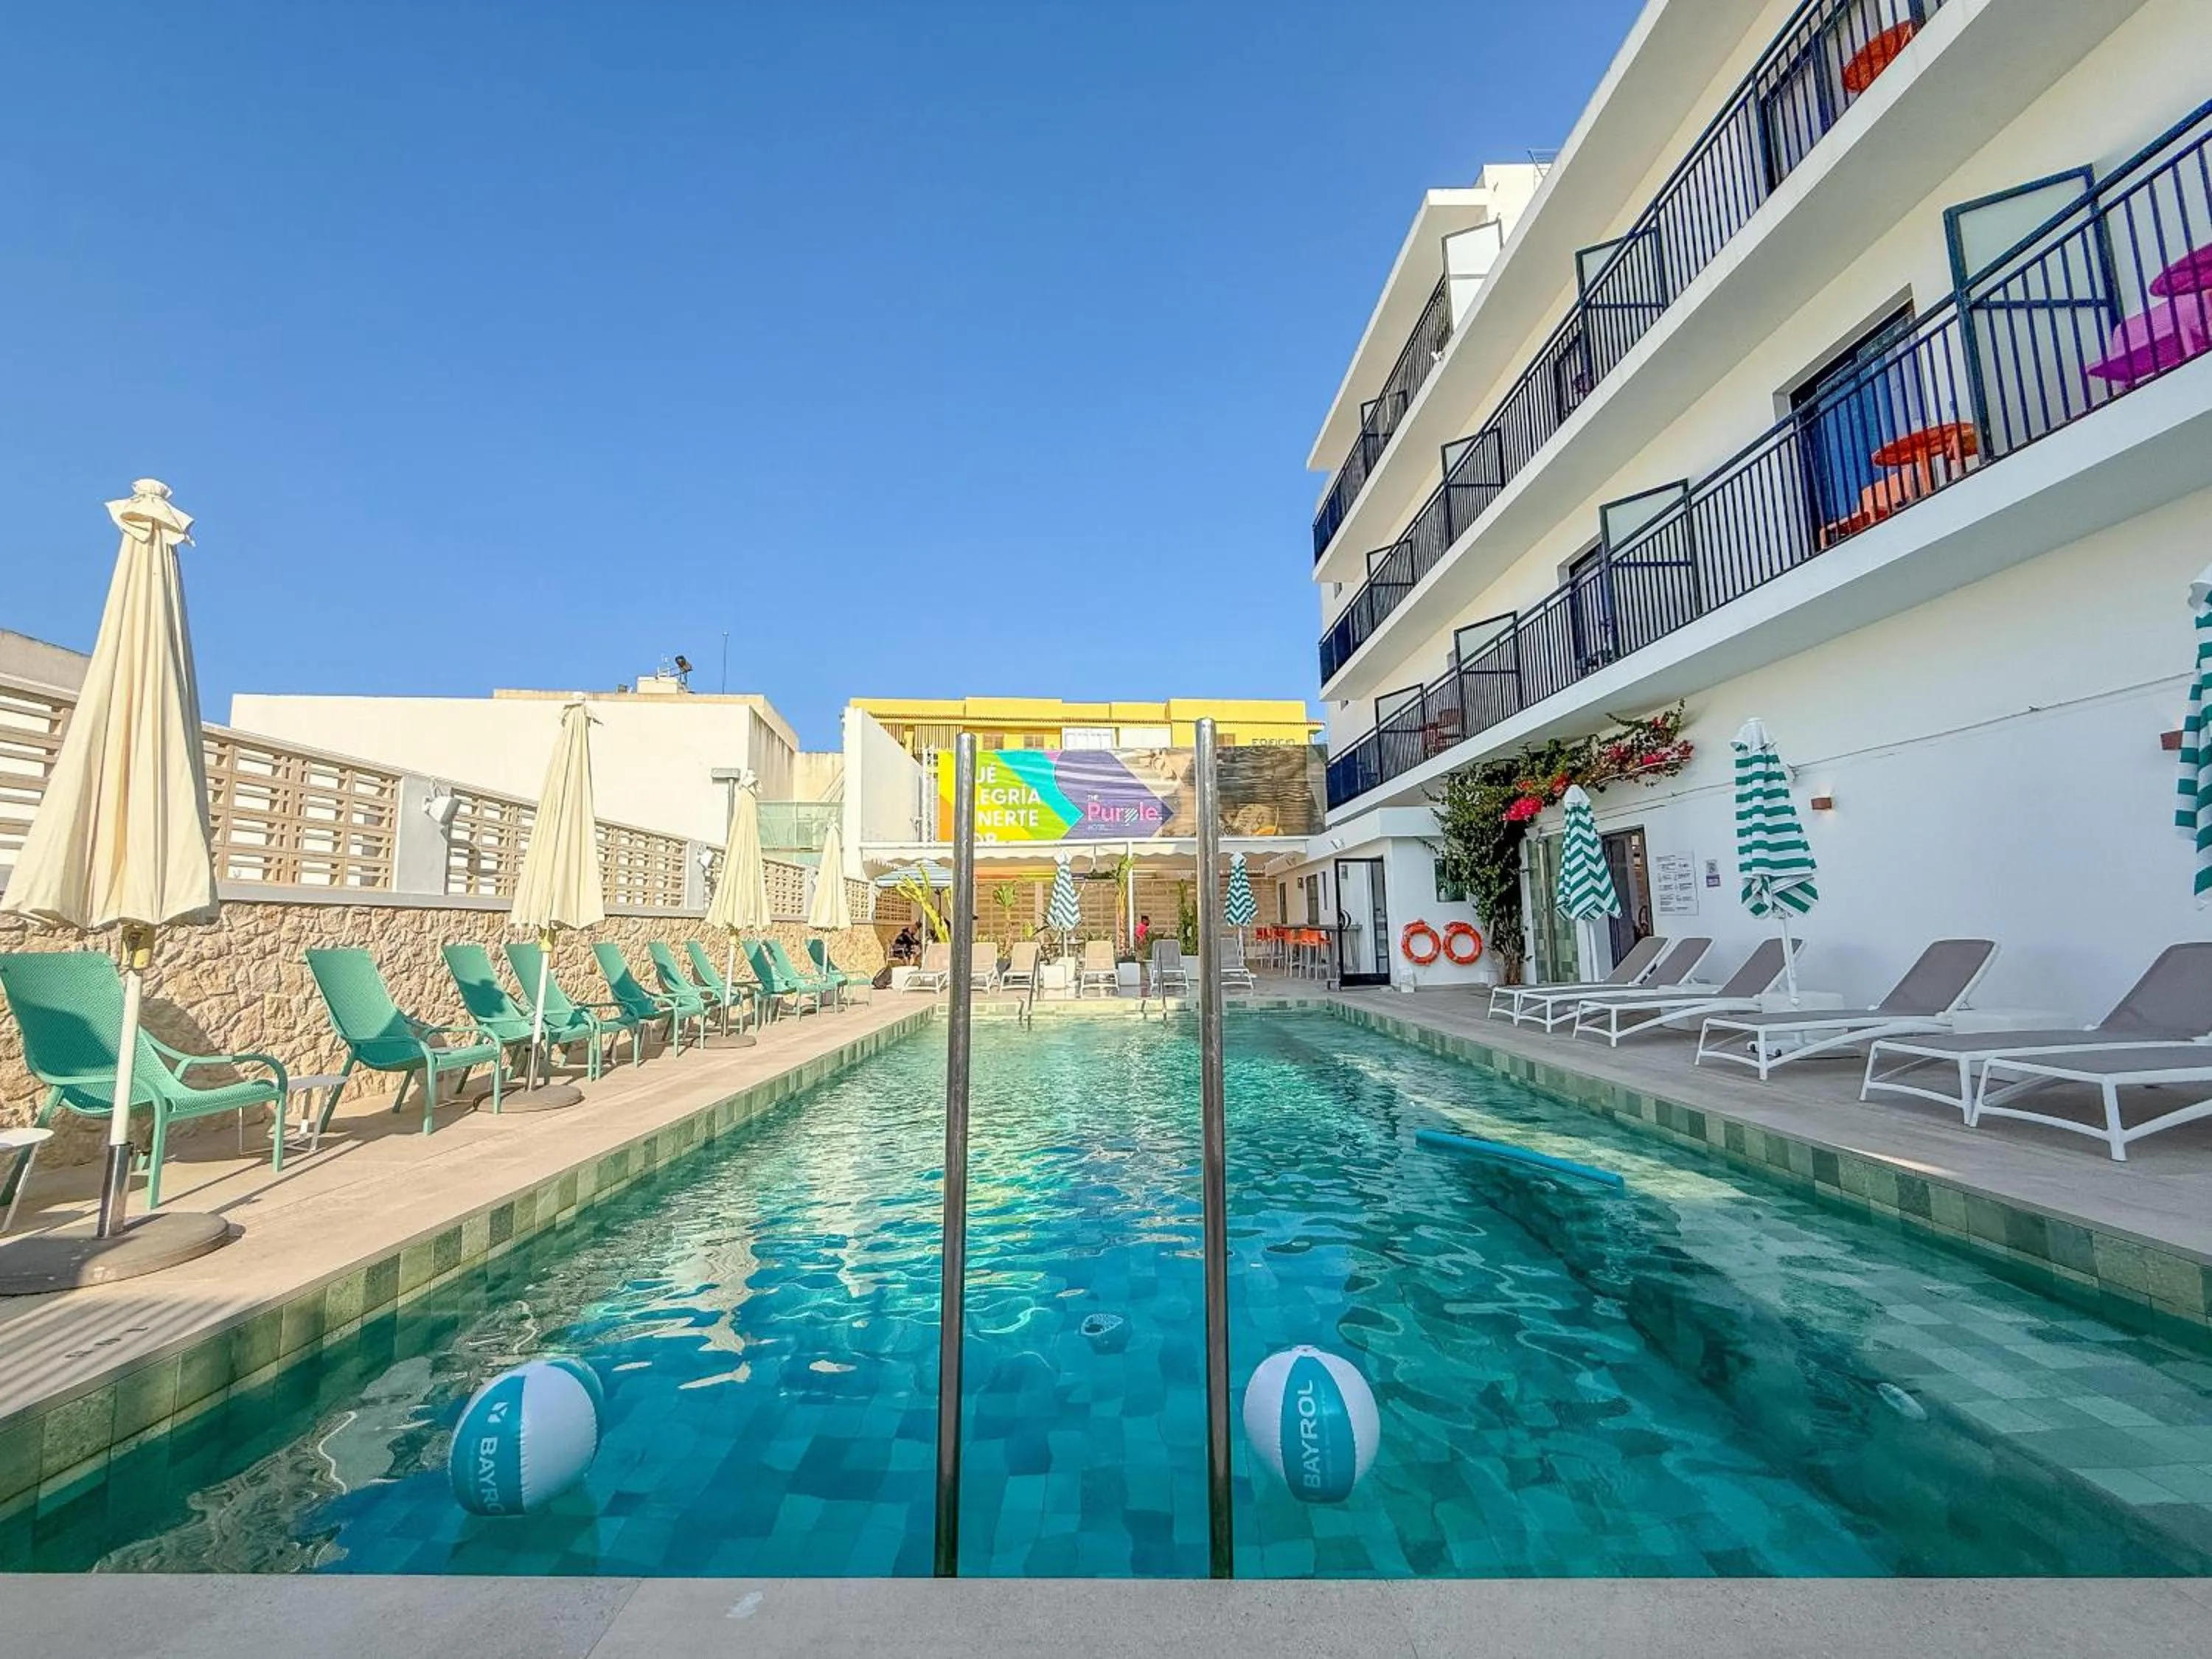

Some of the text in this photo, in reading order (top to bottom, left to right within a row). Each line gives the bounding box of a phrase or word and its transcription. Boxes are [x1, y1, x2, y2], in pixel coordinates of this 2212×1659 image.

[977, 810, 1039, 827] NERTE
[1297, 1380, 1321, 1488] BAYROL
[478, 1436, 506, 1514] BAYRO
